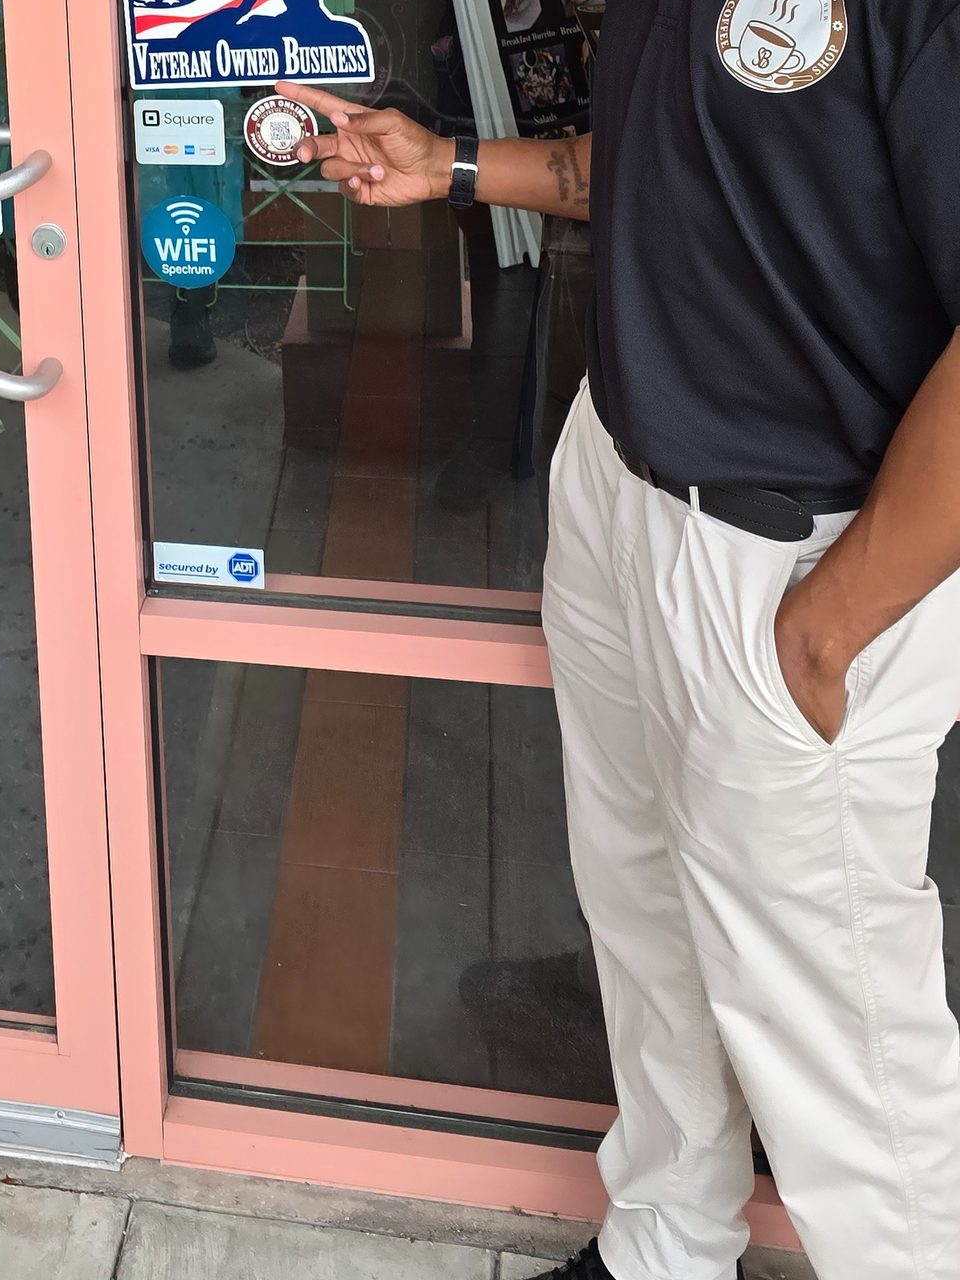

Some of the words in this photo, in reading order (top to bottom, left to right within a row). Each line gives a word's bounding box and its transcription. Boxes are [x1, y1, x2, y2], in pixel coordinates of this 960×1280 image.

[719, 0, 736, 48] COFFEE
[812, 44, 839, 76] SHOP
[133, 42, 212, 80] VETERAN
[215, 39, 280, 78] OWNED
[282, 36, 369, 76] BUSINESS
[164, 112, 215, 127] Square
[251, 100, 276, 121] ORDER
[278, 100, 309, 121] ONLINE
[154, 237, 217, 263] WiFi
[161, 263, 213, 277] Spectrum
[158, 562, 204, 574] secured
[205, 564, 219, 575] by
[233, 562, 255, 574] ADT
